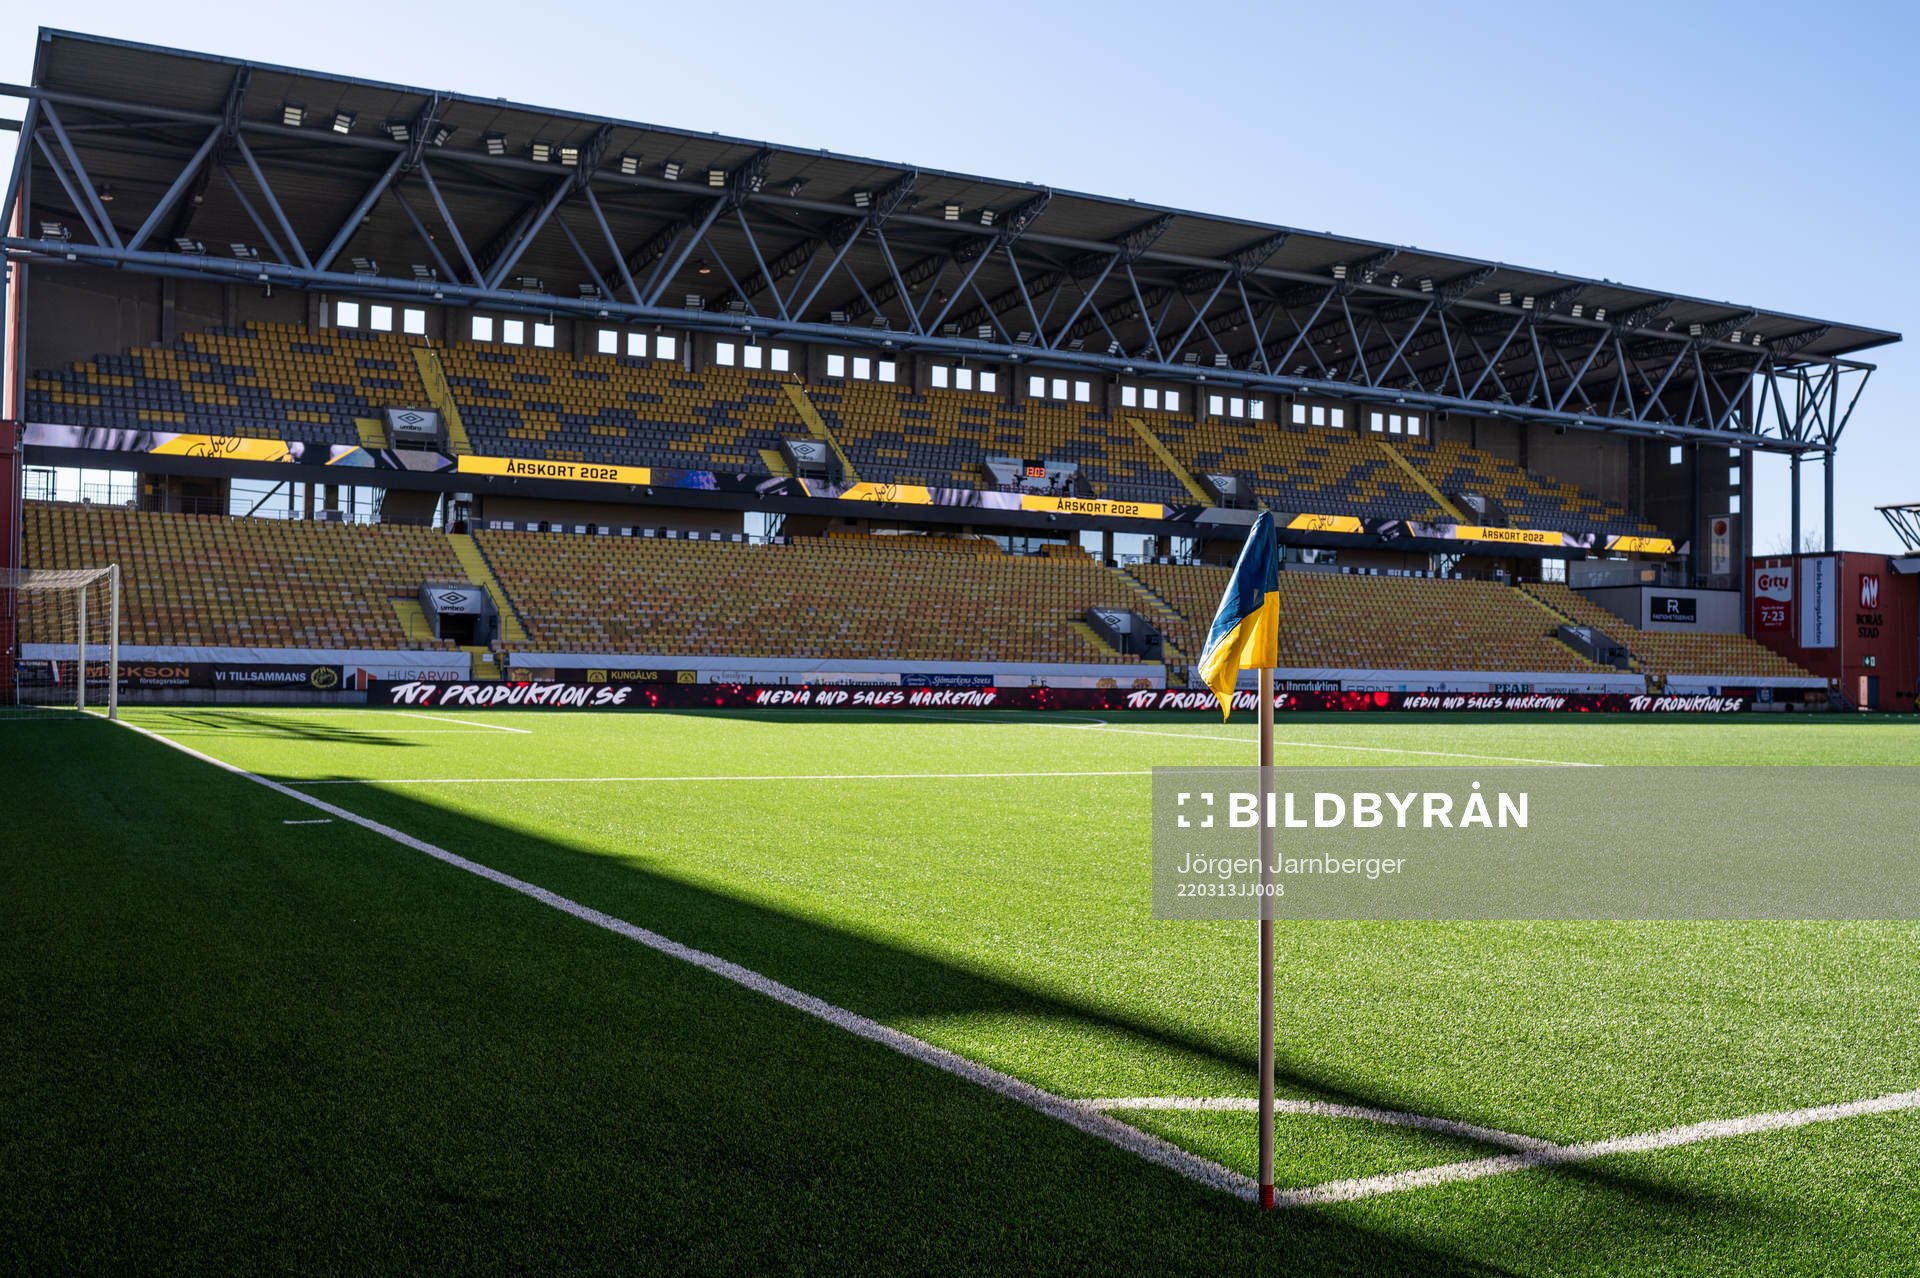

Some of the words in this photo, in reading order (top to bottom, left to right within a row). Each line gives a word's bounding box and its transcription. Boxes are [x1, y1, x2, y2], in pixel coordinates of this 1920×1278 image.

[507, 459, 575, 477] ÅRSKORT
[580, 467, 618, 480] 2022
[1057, 498, 1107, 513] ÅRSKORT
[1111, 504, 1139, 515] 2022
[1482, 528, 1520, 541] ÅRSKORT
[1523, 532, 1544, 543] 2022
[215, 671, 226, 681] VI
[229, 671, 306, 681] TILLSAMMANS
[387, 670, 459, 681] HUSARVID
[1494, 683, 1530, 694] PEAB
[756, 689, 811, 706] MEDIA
[815, 690, 849, 706] AND
[852, 690, 905, 705] SALES
[909, 688, 997, 707] MARKETING
[1403, 695, 1440, 709] MEDIA
[1442, 697, 1465, 709] AND
[1467, 697, 1503, 709] SALES
[1505, 695, 1567, 710] MARKETING
